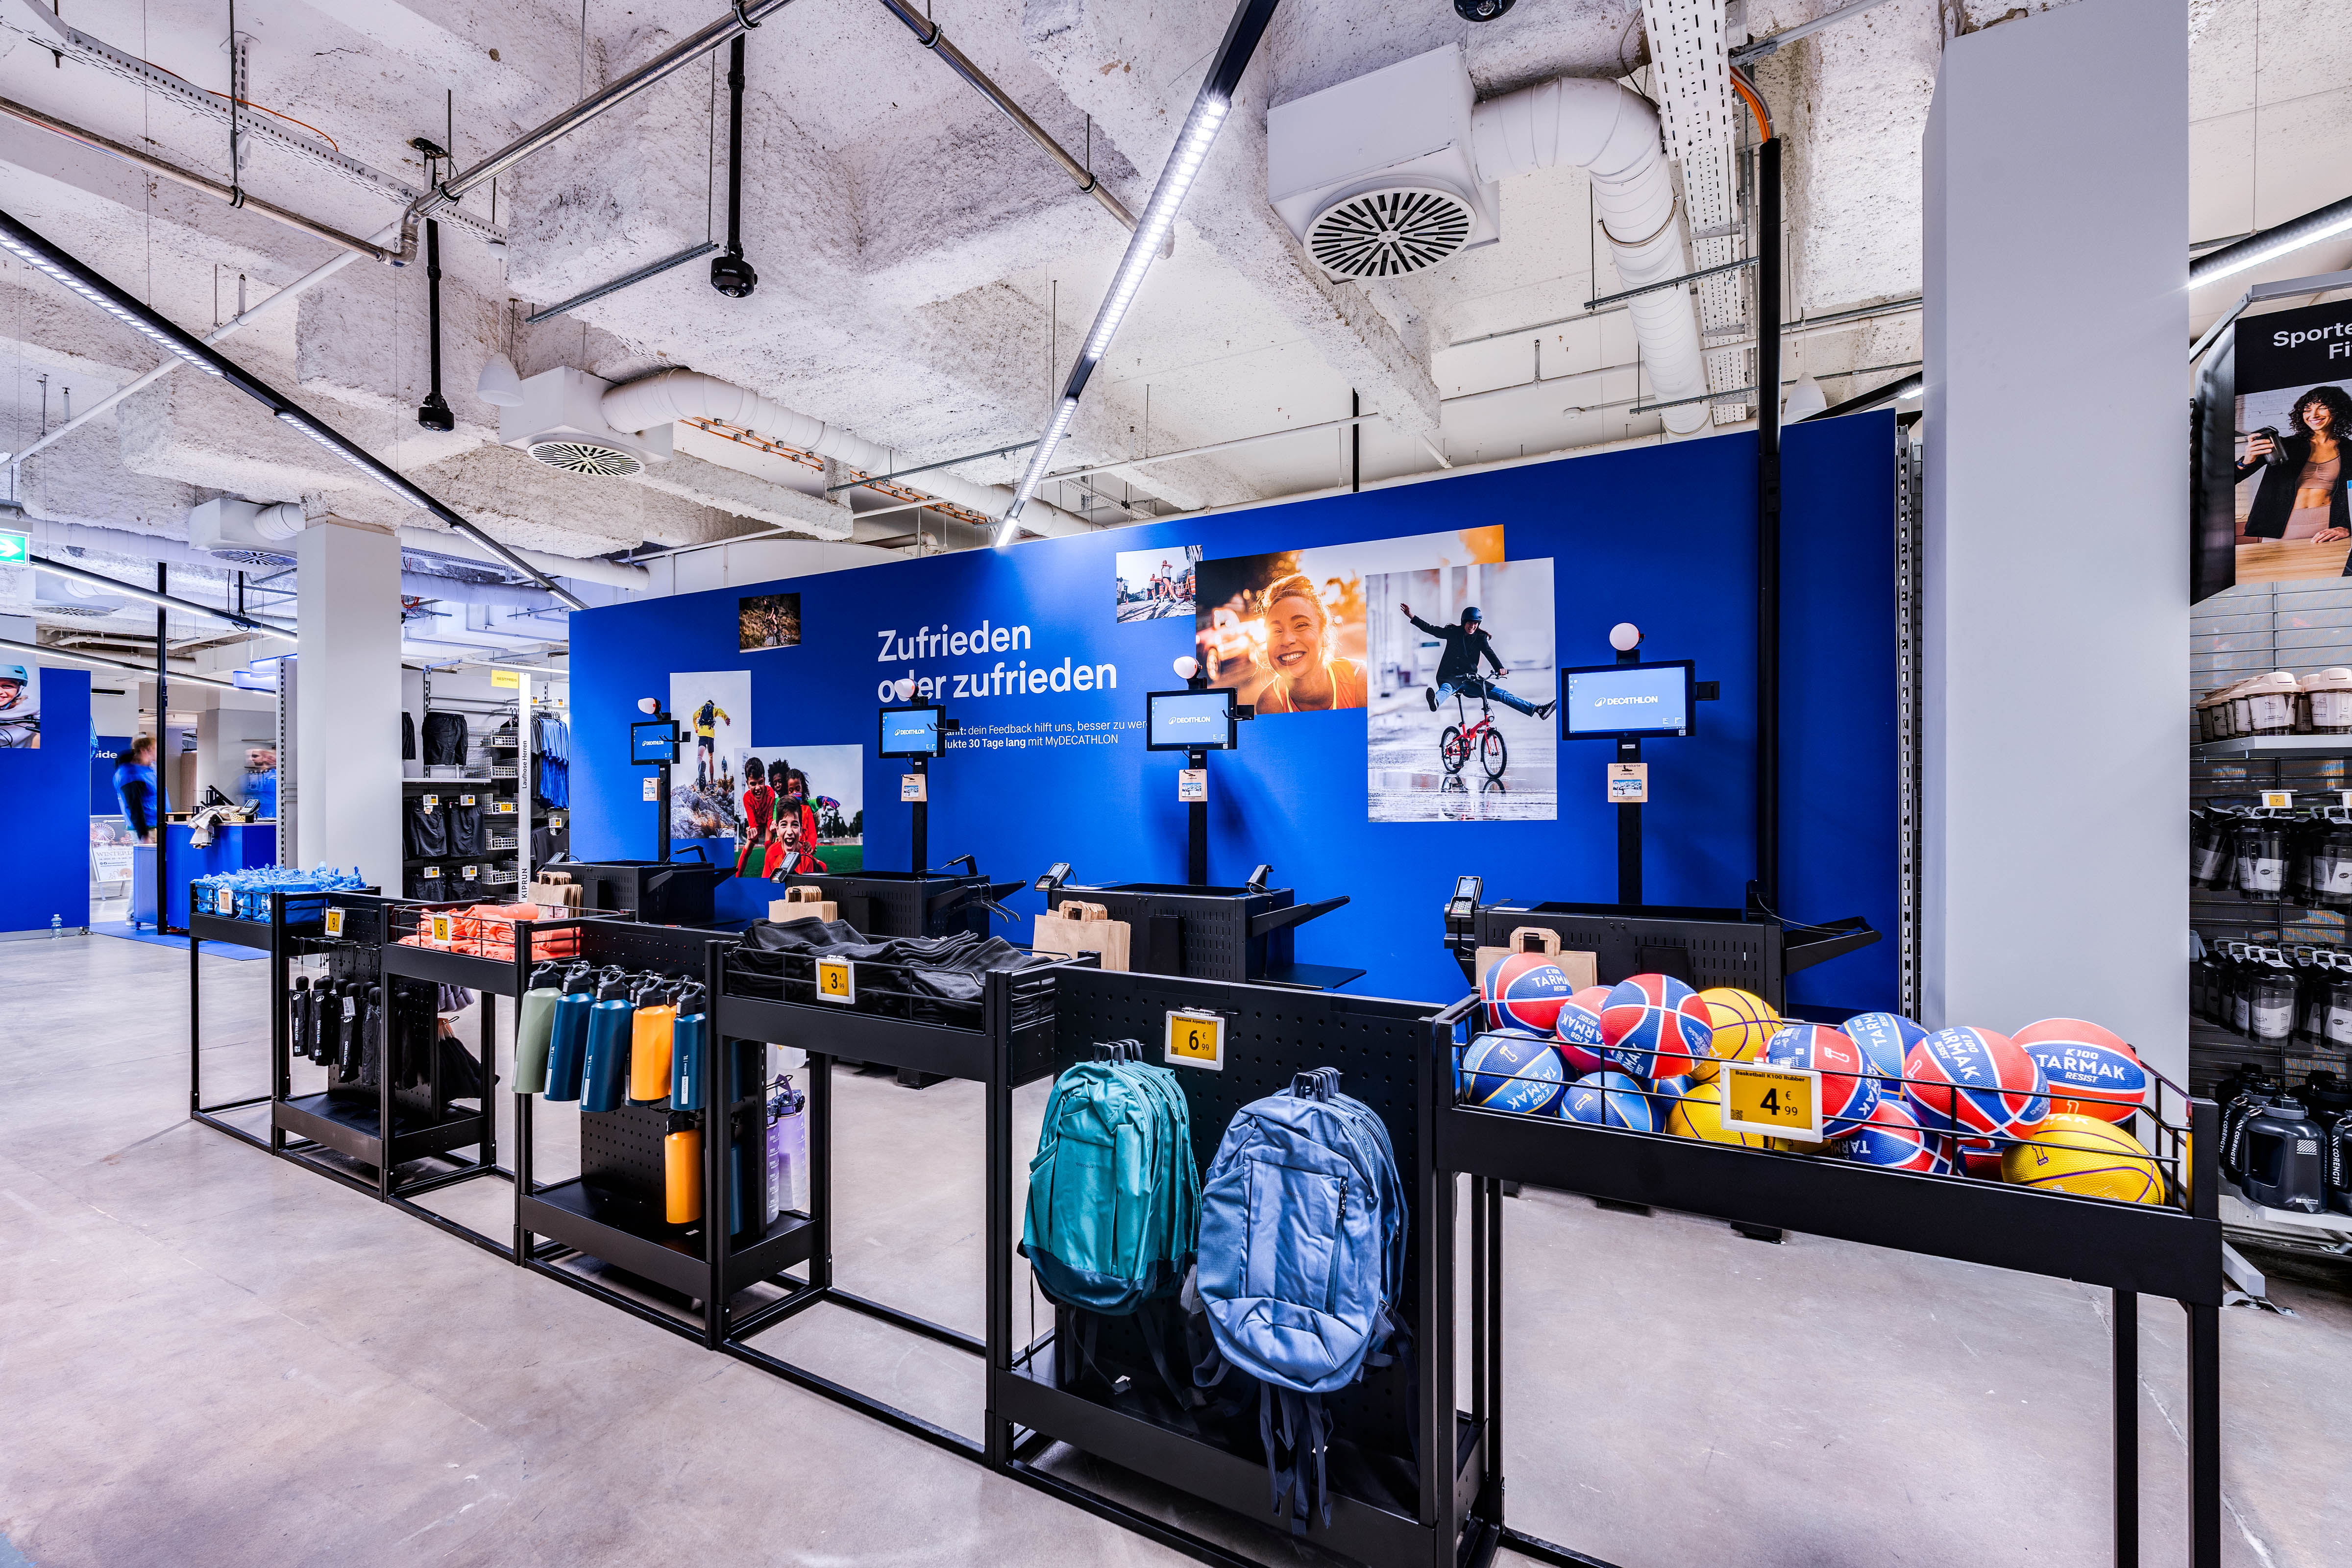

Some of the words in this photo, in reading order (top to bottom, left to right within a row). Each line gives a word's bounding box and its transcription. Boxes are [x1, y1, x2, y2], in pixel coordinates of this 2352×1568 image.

[2329, 341, 2352, 359] Fi
[878, 620, 1031, 662] Zufrieden
[953, 657, 1117, 698] zufrieden
[1607, 696, 1658, 706] DECATHLON
[968, 725, 987, 735] dein
[989, 722, 1032, 735] Feedback
[1034, 722, 1052, 733] hilft
[1054, 723, 1075, 734] uns,
[1078, 721, 1111, 731] besser
[1113, 721, 1125, 730] zu
[968, 738, 980, 748] 30
[981, 738, 1004, 750] Tage
[1005, 737, 1027, 750] lang
[1028, 736, 1044, 746] mit
[1045, 734, 1119, 748] MyDECATHLON
[332, 917, 336, 928] 9
[439, 924, 443, 936] 5
[831, 972, 838, 989] 3
[1561, 1013, 1605, 1044] ARMAK
[1577, 1014, 1598, 1027] RESIST
[1854, 1019, 1865, 1031] K100
[1188, 1029, 1199, 1051] 6
[1960, 1034, 1979, 1053] K100
[1933, 1041, 1951, 1059] RESIST
[1938, 1028, 1981, 1080] TARMAK
[2065, 1048, 2099, 1060] K100
[2036, 1054, 2126, 1080] TARMAK
[1521, 1071, 1539, 1089] REIST
[2065, 1071, 2099, 1083] RESIST
[1533, 1087, 1550, 1105] K100
[1760, 1088, 1781, 1116] 4
[1785, 1091, 1791, 1101] €
[1785, 1106, 1798, 1116] 99
[2219, 1120, 2228, 1154] CORENGTH
[2230, 1130, 2240, 1166] CORENGTH
[2332, 1148, 2341, 1186] CORENGTH
